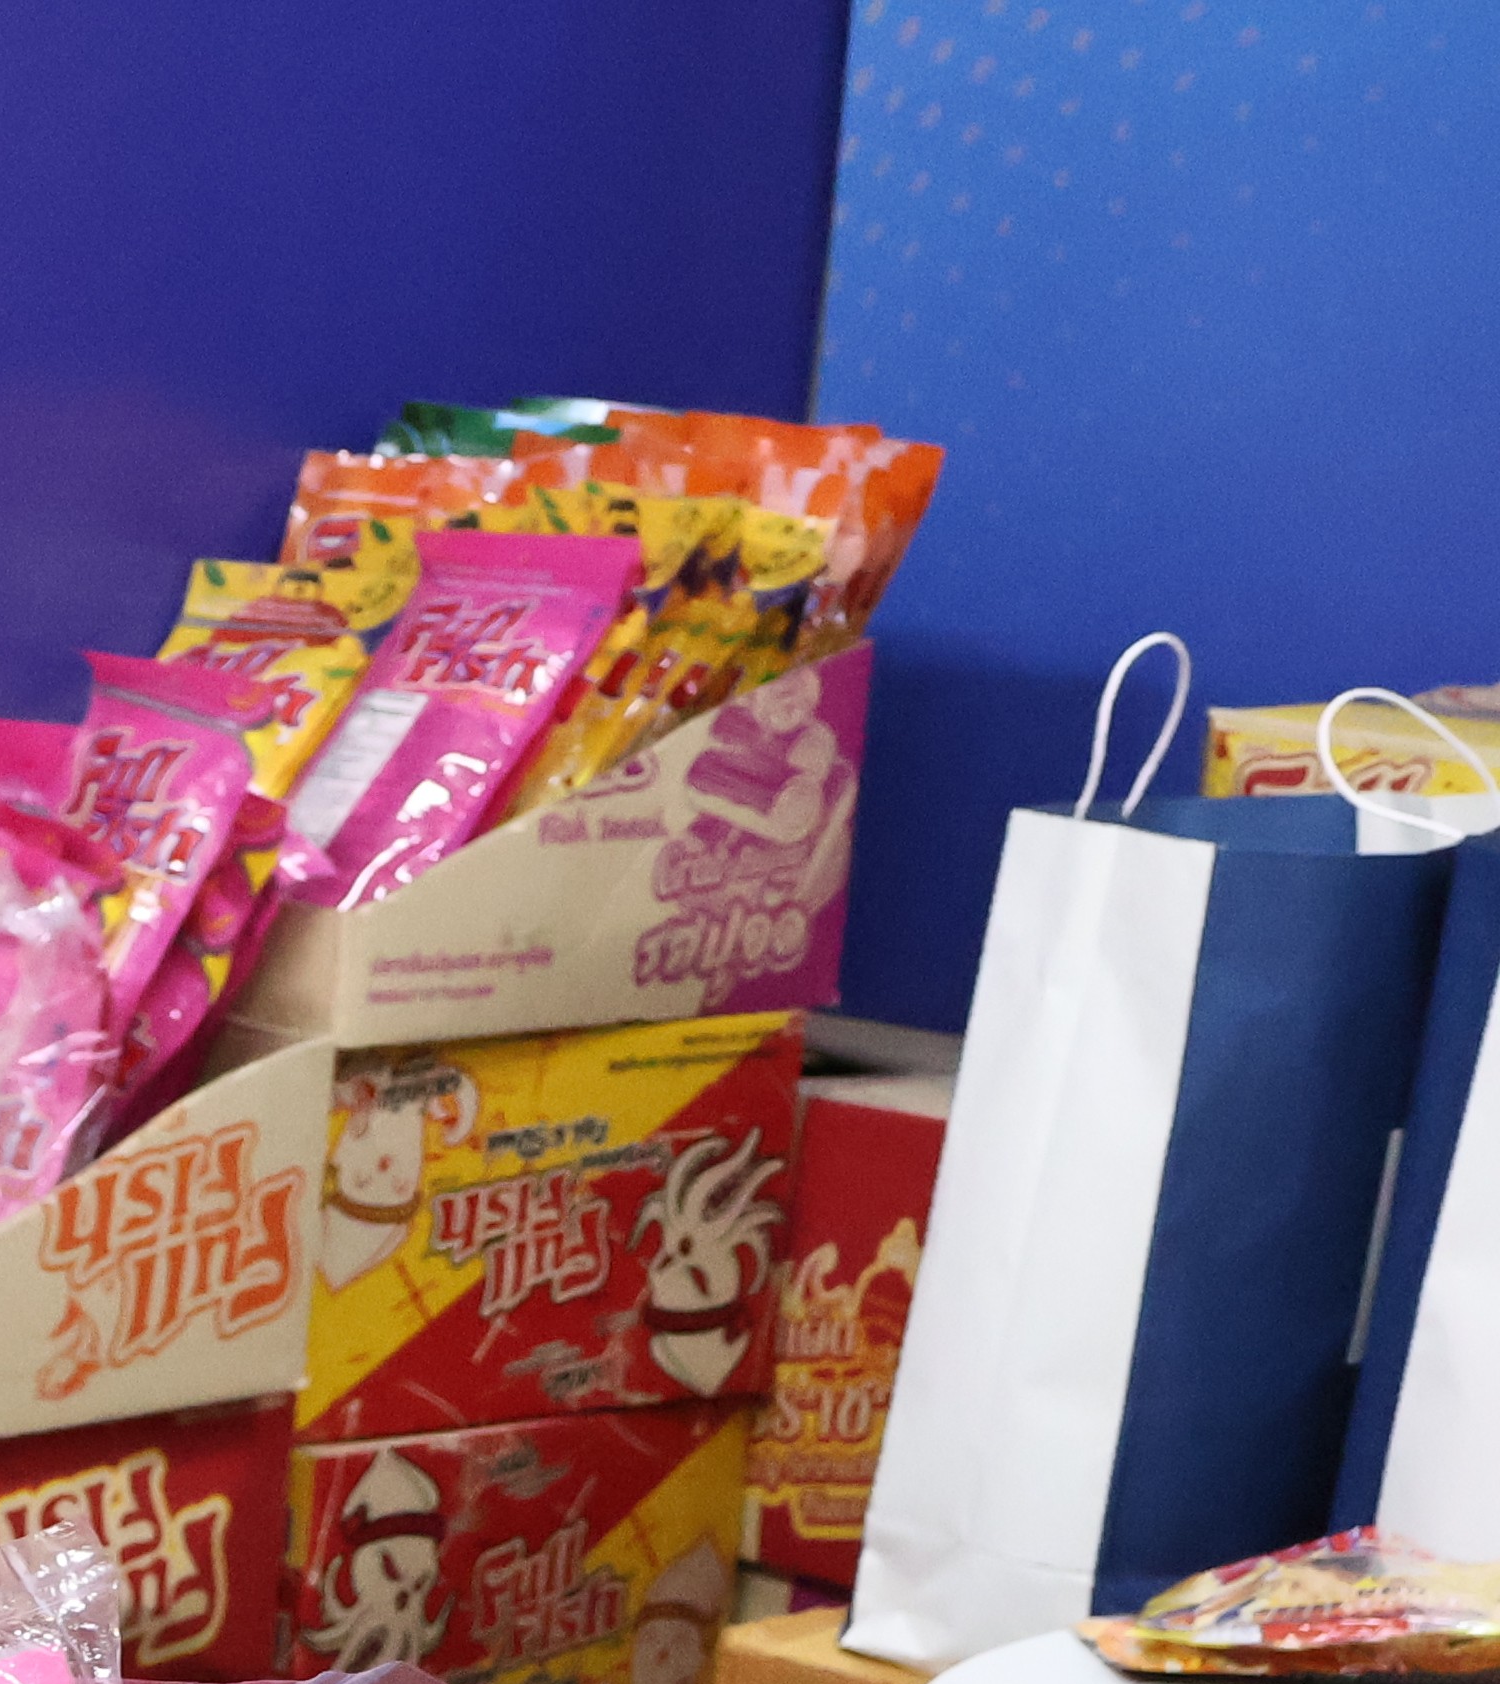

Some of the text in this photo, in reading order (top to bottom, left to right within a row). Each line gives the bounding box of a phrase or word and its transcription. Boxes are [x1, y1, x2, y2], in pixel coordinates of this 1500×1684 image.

[39, 1121, 262, 1274] Fish
[423, 1169, 570, 1273] Fish
[478, 1197, 610, 1318] Full
[106, 1168, 308, 1371] Full
